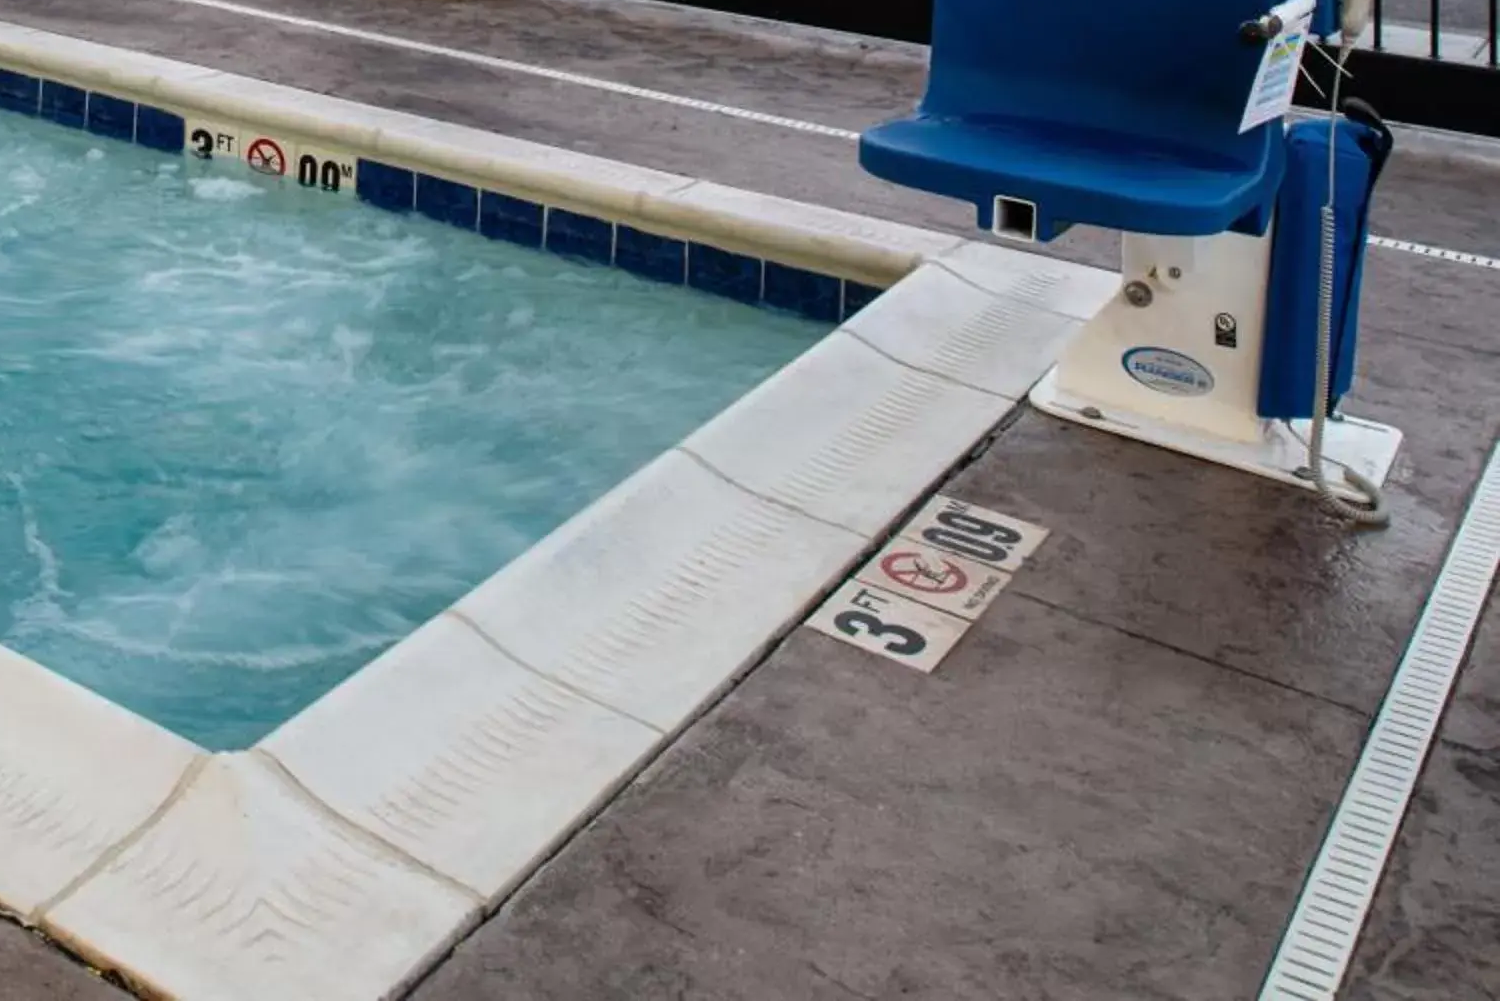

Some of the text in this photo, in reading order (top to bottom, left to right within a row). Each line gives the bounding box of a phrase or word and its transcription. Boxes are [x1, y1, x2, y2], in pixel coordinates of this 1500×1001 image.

[216, 133, 234, 152] FT
[833, 589, 927, 656] 3 FT
